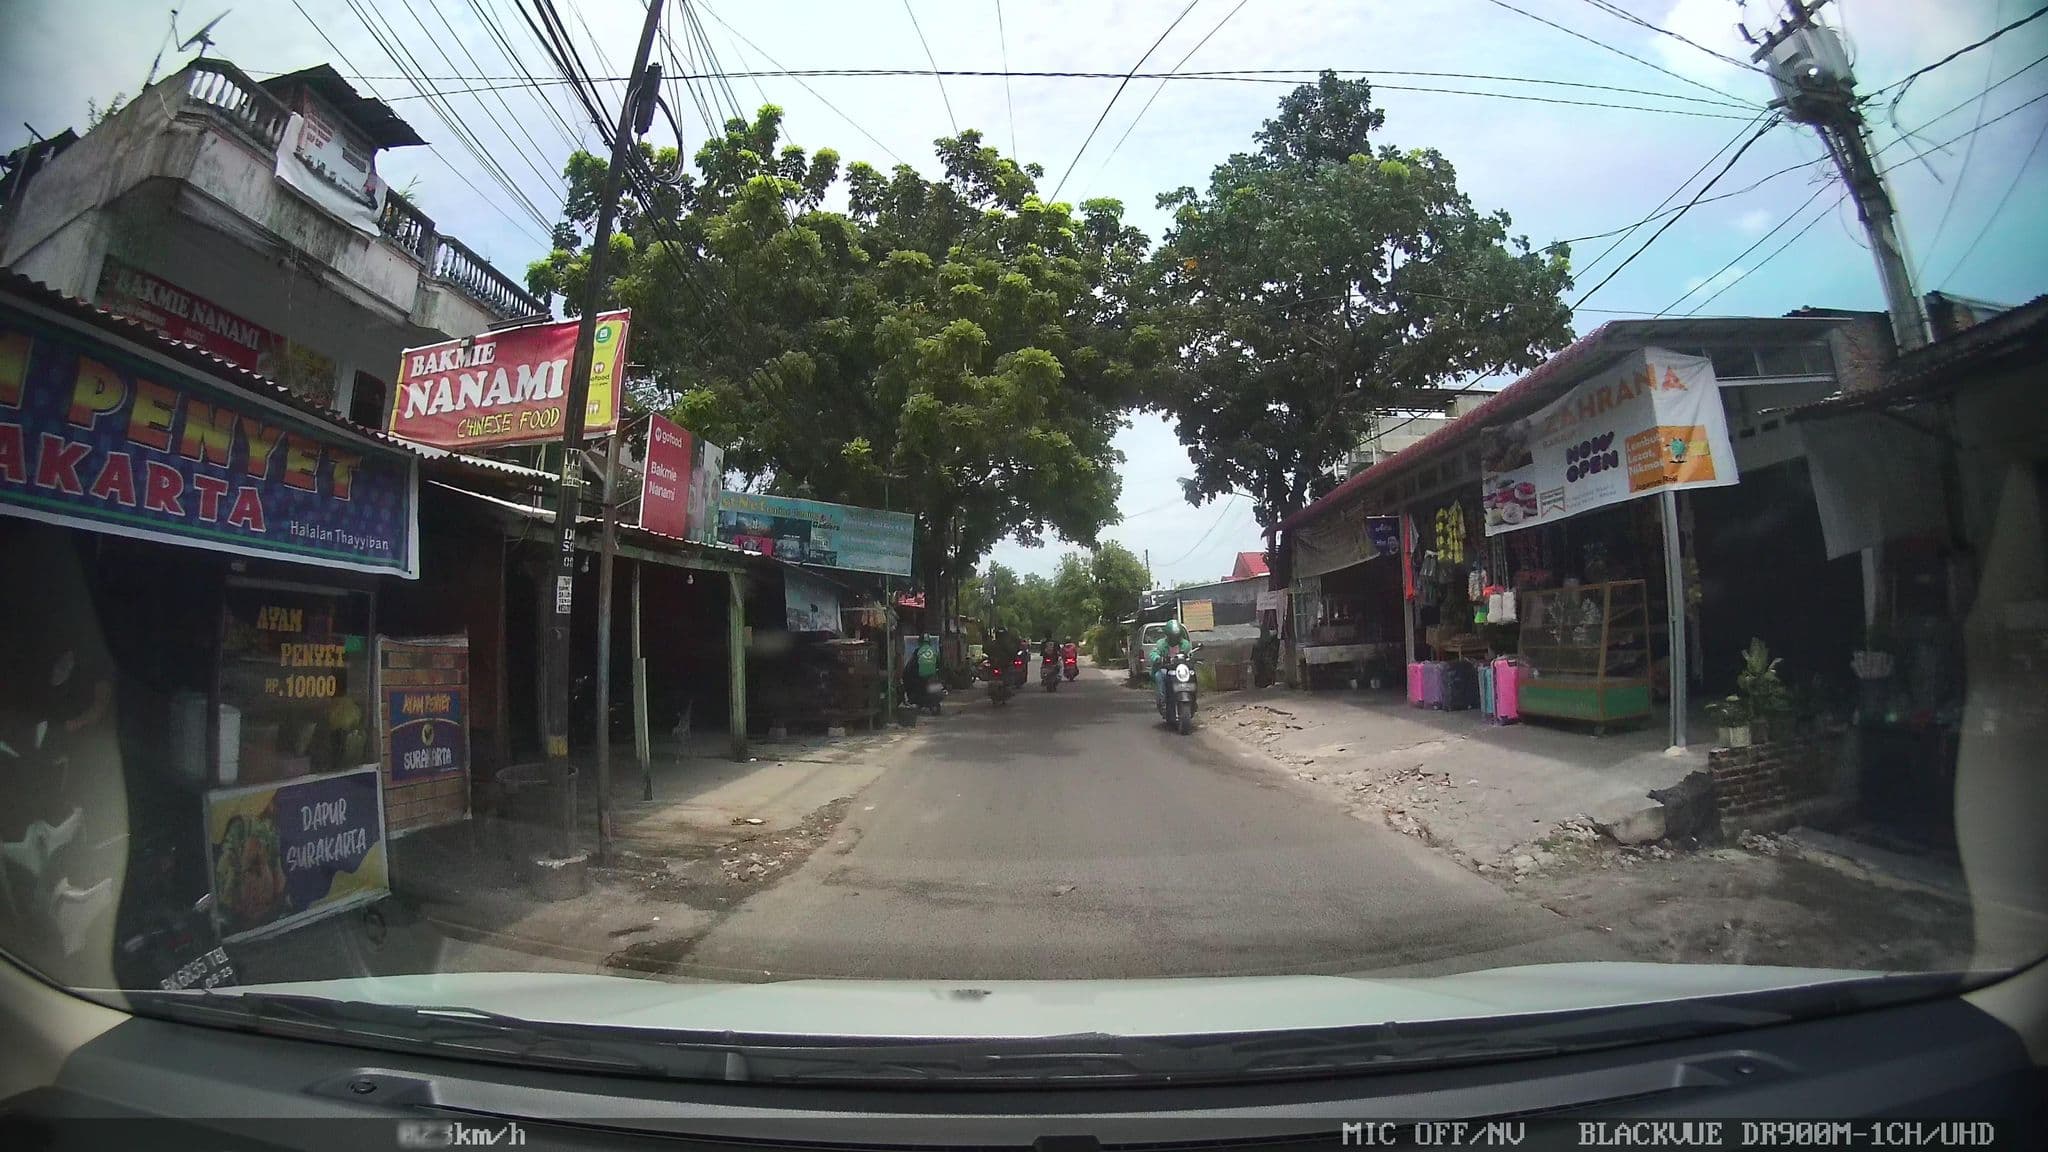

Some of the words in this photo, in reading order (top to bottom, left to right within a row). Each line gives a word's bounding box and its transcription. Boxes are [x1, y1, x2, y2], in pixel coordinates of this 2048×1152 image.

[115, 266, 191, 317] BAKMIE
[192, 301, 261, 350] NANAMI
[411, 341, 497, 378] BAKMIE
[404, 359, 568, 419] NANAMI
[1544, 363, 1689, 434] ZAHRANA
[67, 354, 363, 501] PENYET
[457, 412, 514, 438] CHINESE
[519, 407, 561, 431] FOOD
[662, 431, 683, 449] gofood
[1566, 430, 1615, 465] NOW
[650, 461, 677, 482] Bakmie
[1566, 450, 1619, 483] OPEN
[648, 481, 676, 501] Nanami
[290, 520, 333, 542] Halalan
[334, 529, 390, 552] Thayyiban
[256, 606, 303, 632] AYAM
[280, 643, 346, 668] PENYET
[402, 694, 425, 715] AYAM
[403, 746, 452, 770] SURAKARTA
[301, 797, 347, 831] DAPUR
[286, 827, 368, 872] SURAKARTA
